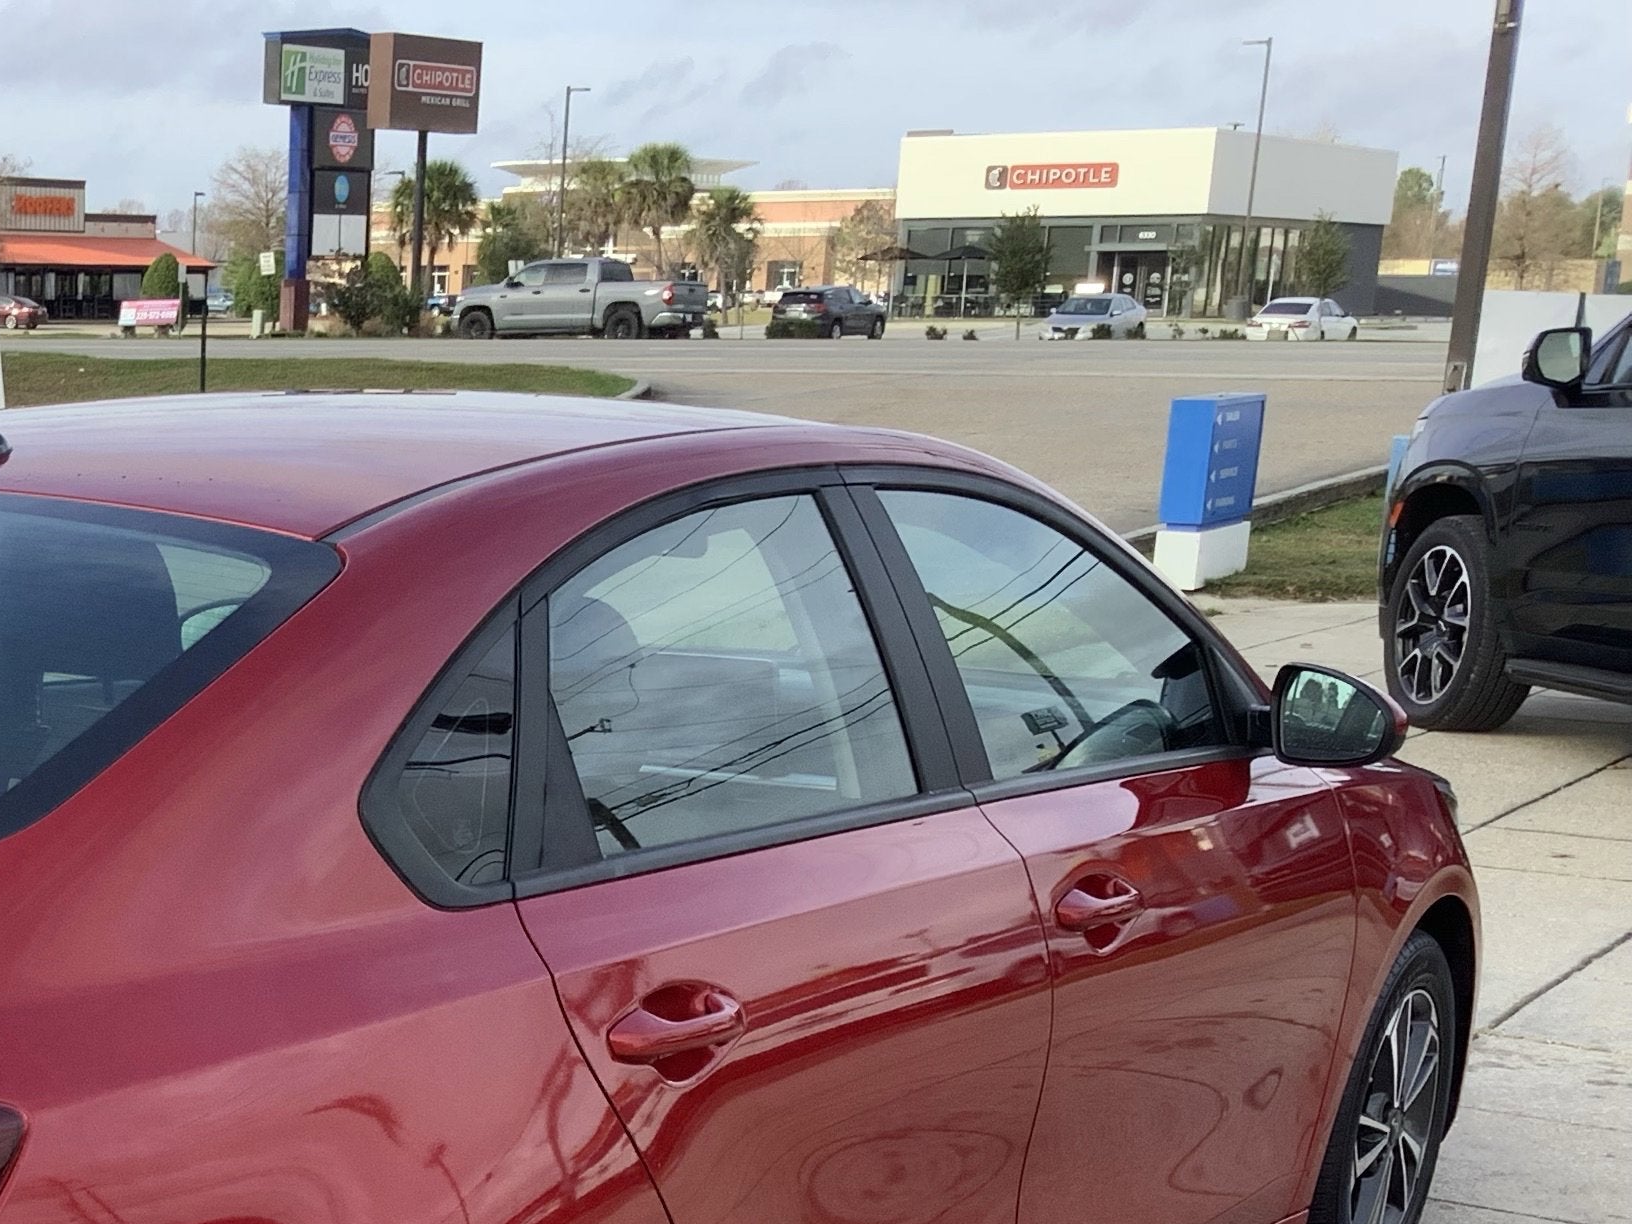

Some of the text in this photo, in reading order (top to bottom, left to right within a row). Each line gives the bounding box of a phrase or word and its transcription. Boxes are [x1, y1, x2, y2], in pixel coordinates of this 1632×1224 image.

[309, 65, 342, 86] Express
[413, 68, 472, 89] CHIPOTLE
[421, 95, 470, 108] MEXICAN GRILL
[1012, 167, 1113, 185] CHIPOTLE
